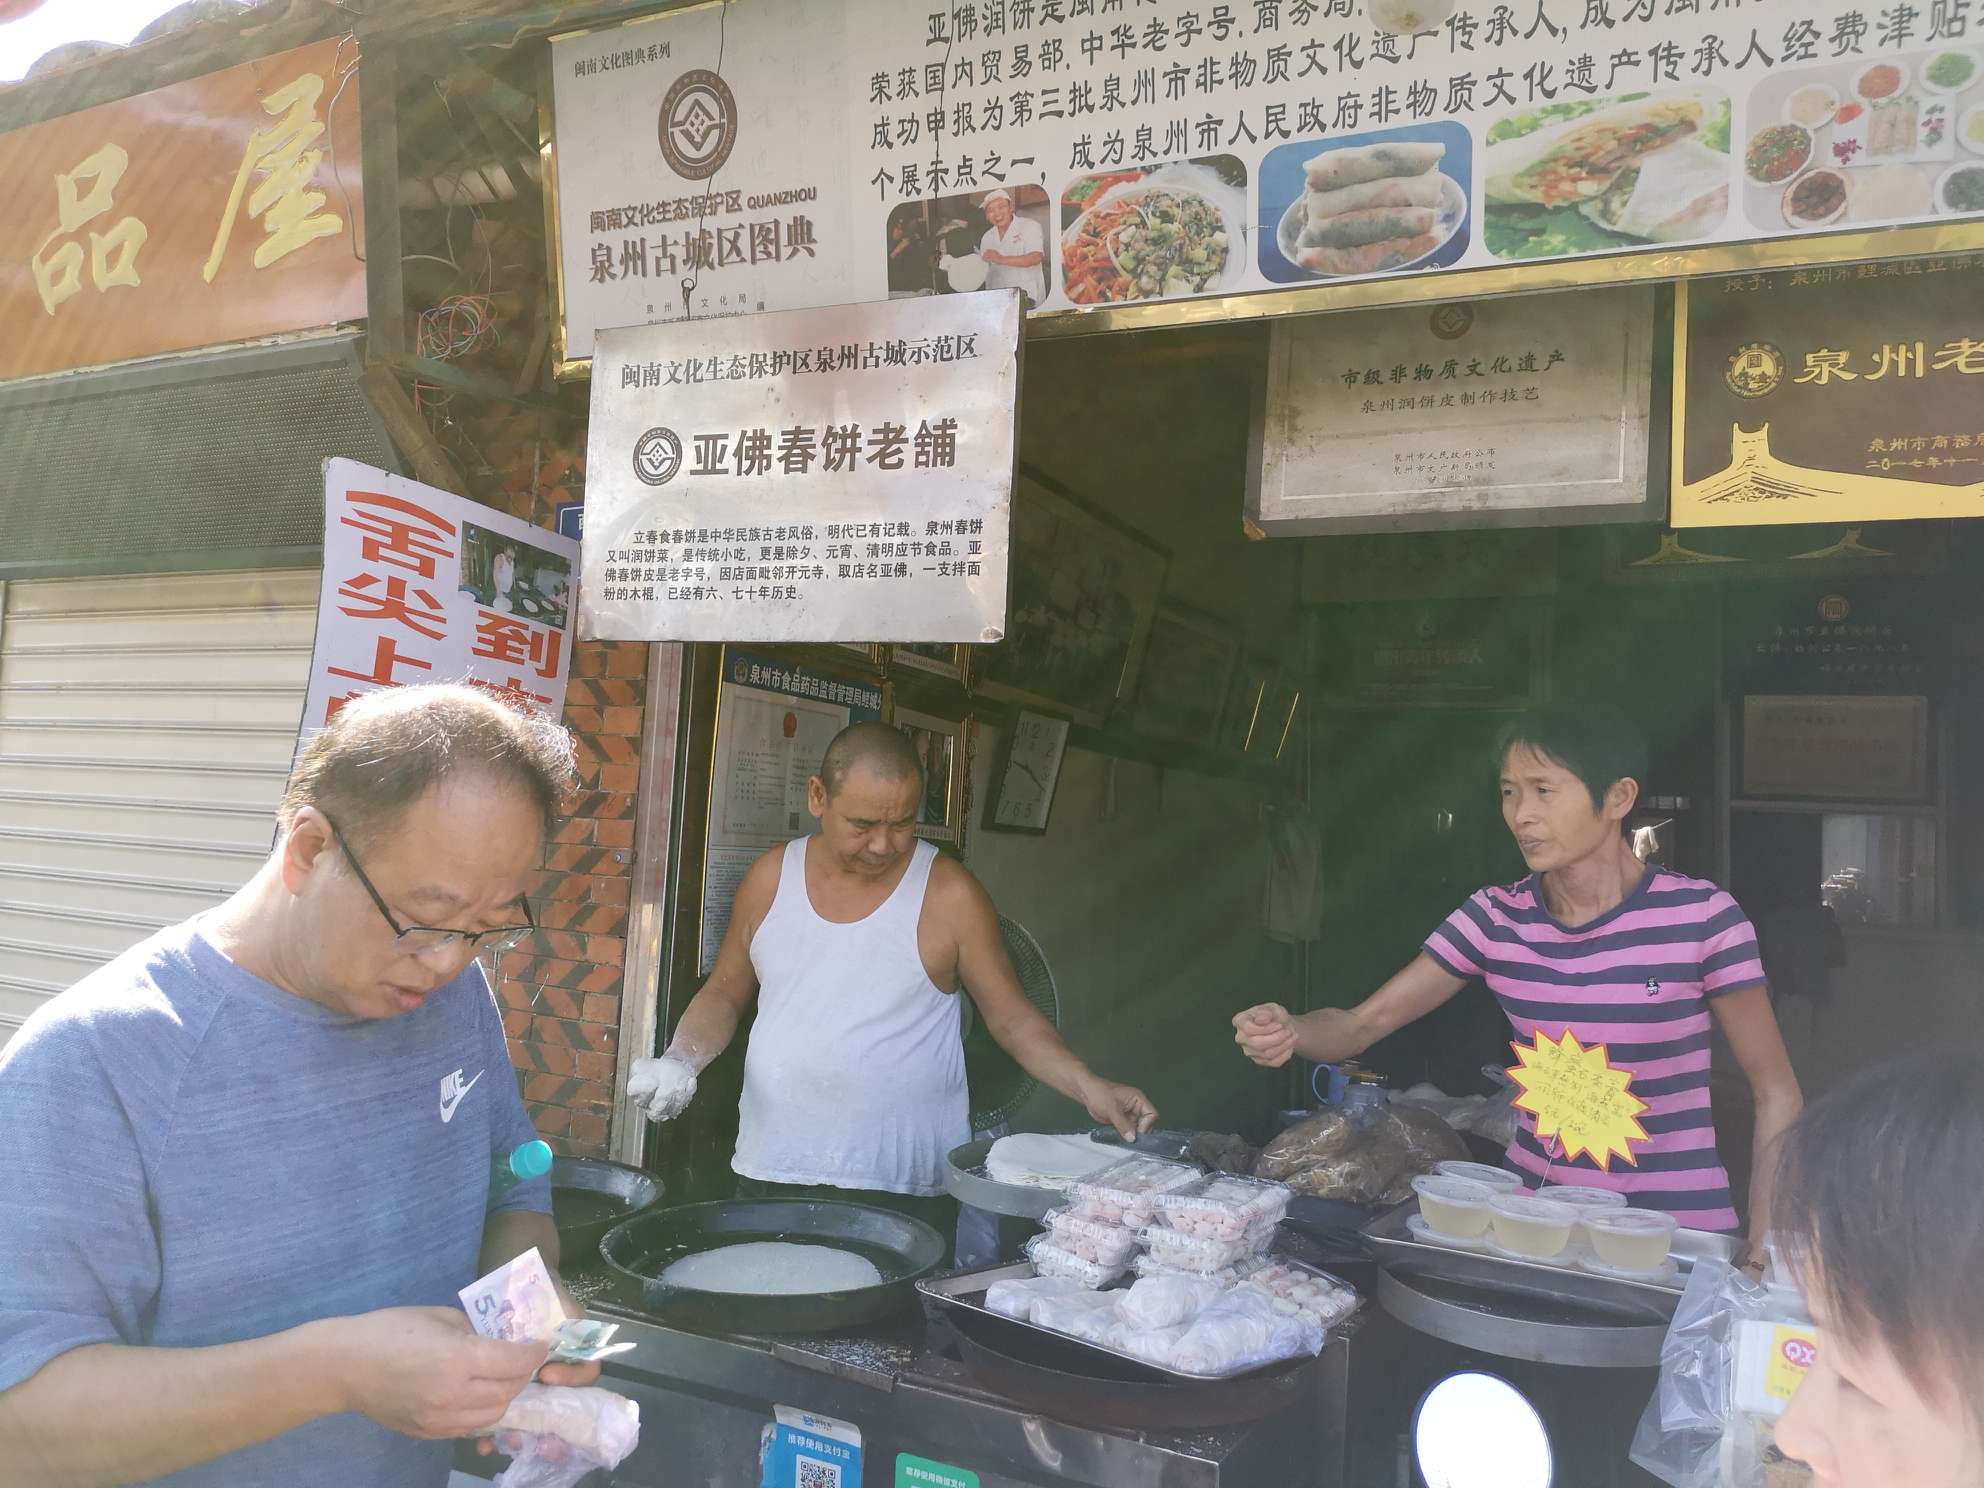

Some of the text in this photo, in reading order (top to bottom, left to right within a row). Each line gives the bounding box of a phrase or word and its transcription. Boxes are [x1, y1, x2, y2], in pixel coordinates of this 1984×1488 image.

[574, 41, 671, 78] 闽南文化图典系列
[870, 0, 1984, 201] 个展示点之一，成为泉州市人民政府非物质文化遗产传承人经费津贴
[590, 186, 818, 234] 闽南文化生态保护区 QUANZHOU
[589, 215, 819, 284] 泉州古城区图典
[646, 293, 748, 314] 泉州文化局
[620, 332, 979, 389] 闽南文化生态保护区泉州古城示范区
[1341, 349, 1568, 390] 市级非物质文化遗产
[1360, 386, 1541, 414] 泉州润饼皮制作技艺
